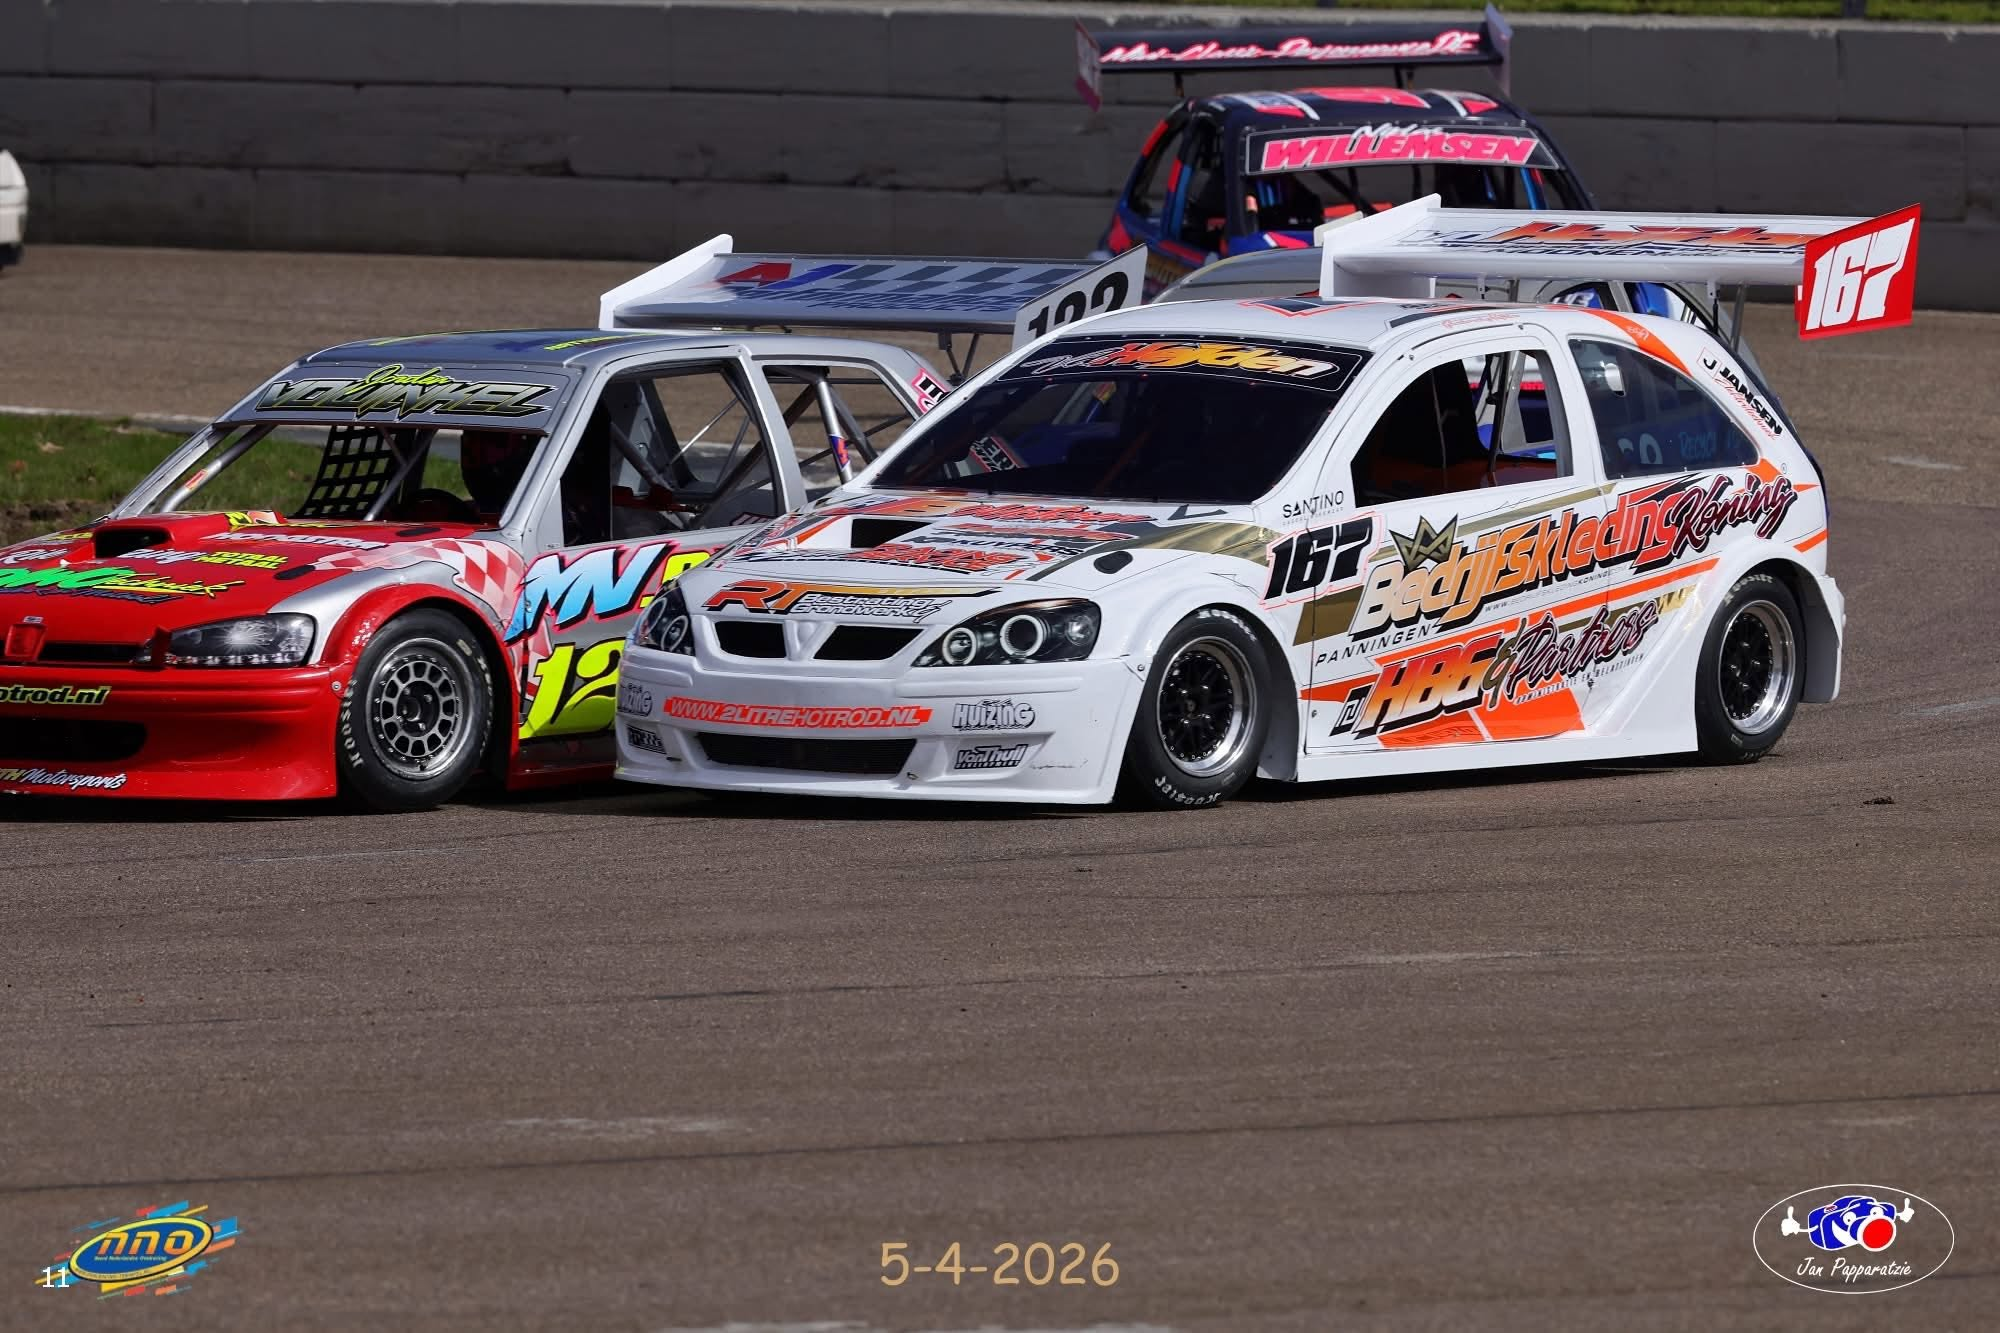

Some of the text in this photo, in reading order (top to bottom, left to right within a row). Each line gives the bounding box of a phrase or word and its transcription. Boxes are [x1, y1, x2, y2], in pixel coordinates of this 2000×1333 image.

[1261, 134, 1541, 172] WILLEMSEN
[1805, 218, 1916, 331] 167
[1719, 366, 1783, 436] JANSEN
[1283, 490, 1345, 518] SANTINO
[1672, 474, 1798, 554] Koning
[194, 556, 280, 570] METAAL
[211, 551, 289, 563] TOTAAL
[952, 540, 1085, 556] KUYPERS
[1263, 517, 1373, 601] 167
[798, 593, 934, 611] Bestrating
[1316, 626, 1431, 667] PANNINGEN
[1354, 632, 1505, 739] HBG
[1505, 600, 1660, 700] Partners
[671, 698, 922, 730] WWW.2LITREHOTROD.NL
[952, 702, 1036, 730] HUIZING
[20, 768, 127, 790] Motorsports
